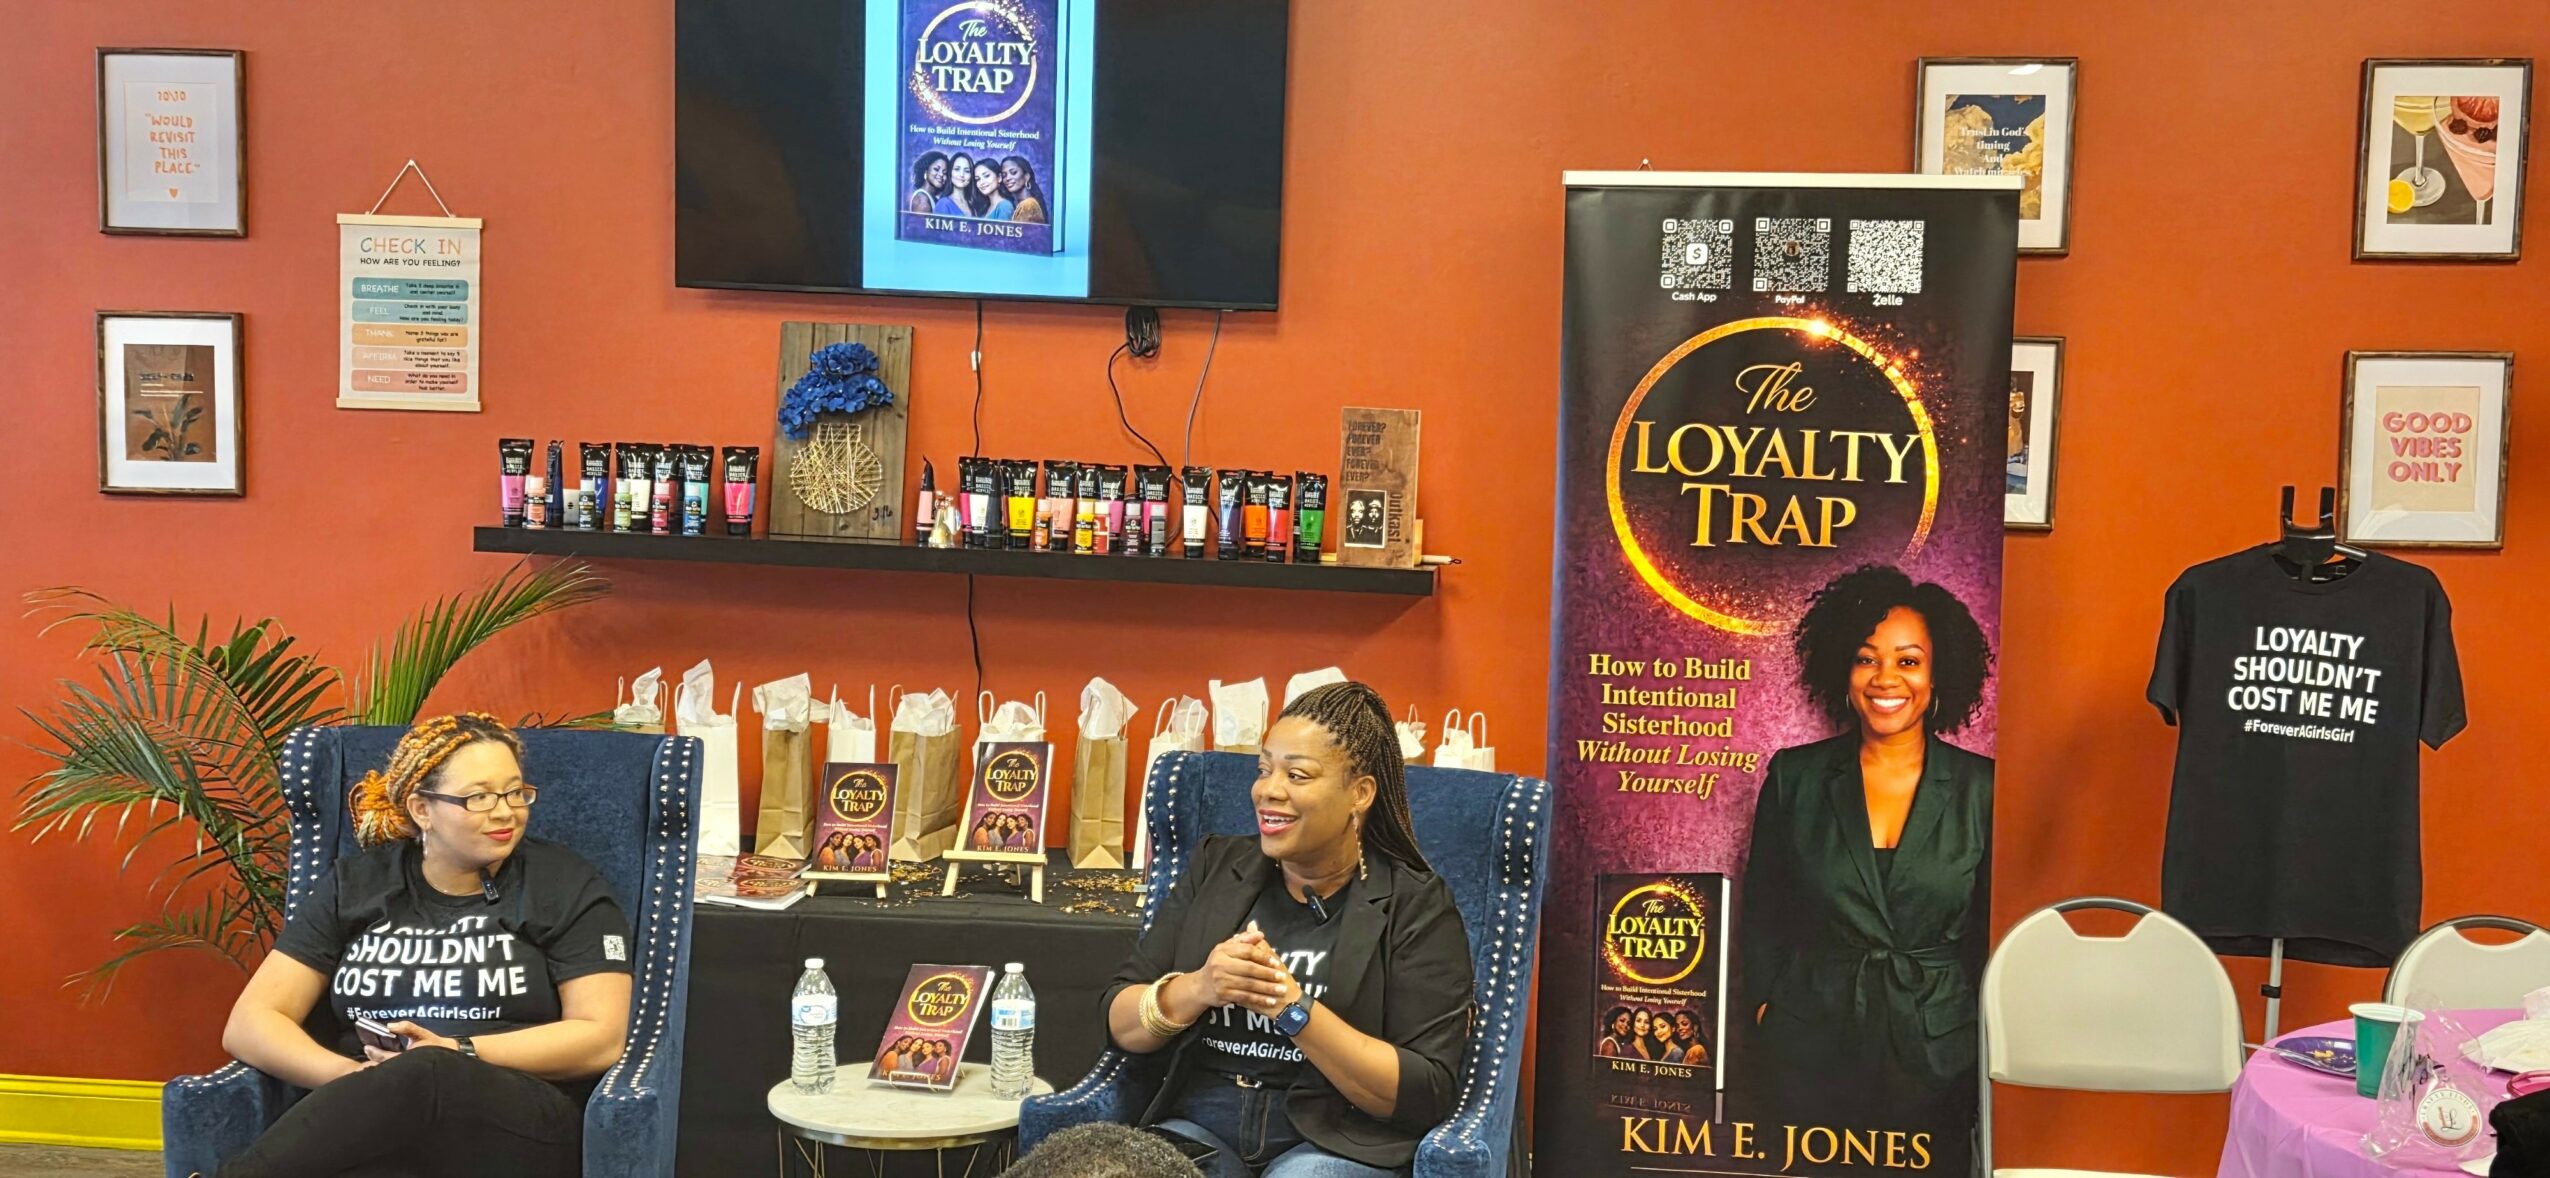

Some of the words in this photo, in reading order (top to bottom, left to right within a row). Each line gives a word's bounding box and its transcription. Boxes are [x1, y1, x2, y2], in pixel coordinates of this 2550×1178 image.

[959, 19, 988, 42] The
[918, 38, 1036, 66] LOYALTY
[932, 66, 1014, 93] TRAP
[149, 131, 195, 143] REVISIT
[910, 125, 926, 133] How
[936, 126, 956, 135] Build
[957, 127, 997, 137] Intentional
[998, 130, 1040, 139] Sisterhood
[159, 147, 187, 159] THIS
[933, 137, 962, 146] Without
[963, 138, 985, 149] Losing
[986, 140, 1017, 151] Yourself
[1976, 140, 2011, 151] timing
[1982, 153, 2004, 163] And
[925, 218, 953, 231] KIM
[960, 221, 971, 233] E.
[977, 222, 1023, 237] JONES
[360, 237, 426, 254] CHECK
[437, 238, 461, 255] IN
[360, 257, 380, 265] HOW
[383, 258, 399, 266] ARE
[402, 259, 420, 267] YOU
[422, 259, 461, 267] FEELING?
[361, 284, 399, 293] BREATHE
[1671, 291, 1696, 302] Cash
[1697, 292, 1717, 304] App
[1775, 294, 1806, 305] PayPal
[1872, 294, 1904, 306] Zelle
[369, 306, 389, 315] FEEL
[365, 329, 393, 337] THANK
[368, 375, 391, 383] NEED
[1734, 361, 1818, 415] The
[2382, 411, 2472, 434] GOOD
[1347, 432, 1381, 445] FOREVER
[2390, 436, 2462, 458] VIBES
[1631, 421, 1922, 484] LOYALTY
[1346, 470, 1370, 483] EVER?
[2387, 461, 2463, 483] ONLY
[1680, 482, 1857, 549] TRAP
[2255, 626, 2365, 660] LOYALTY
[1588, 654, 1646, 677] How
[1653, 657, 1677, 678] to
[1683, 657, 1752, 681] Build
[2233, 656, 2382, 694] SHOULDN'T
[1600, 683, 1737, 709] Intentional
[2228, 686, 2293, 713] COST
[2299, 690, 2334, 718] ME
[2339, 694, 2380, 725] ME
[1602, 711, 1733, 738] Sisterhood
[2243, 718, 2355, 743] #ForeverAGirlsGirl
[1577, 739, 1672, 764] Without
[1675, 744, 1760, 773] Losing
[853, 778, 867, 788] The
[987, 768, 1037, 780] LOYALTY
[832, 787, 884, 800] LOYALTY
[995, 780, 1026, 792] TRAP
[1617, 770, 1720, 800] Yourself
[841, 800, 874, 812] TRAP
[1642, 899, 1666, 917] The
[1609, 914, 1705, 937] LOYALTY
[346, 934, 515, 965] SHOULDN'T
[1620, 936, 1687, 959] TRAP
[333, 966, 403, 998] COST
[413, 969, 463, 998] ME
[478, 966, 527, 998] ME
[1622, 985, 1638, 993] Build
[912, 989, 969, 1005] LOYALTY
[919, 1003, 954, 1016] TRAP
[1611, 1061, 1636, 1072] KIM
[1640, 1064, 1650, 1074] E.
[1654, 1065, 1692, 1078] JONES
[1620, 1116, 1716, 1157] KIM
[1730, 1122, 1765, 1159] E.
[1779, 1125, 1932, 1172] JONES
